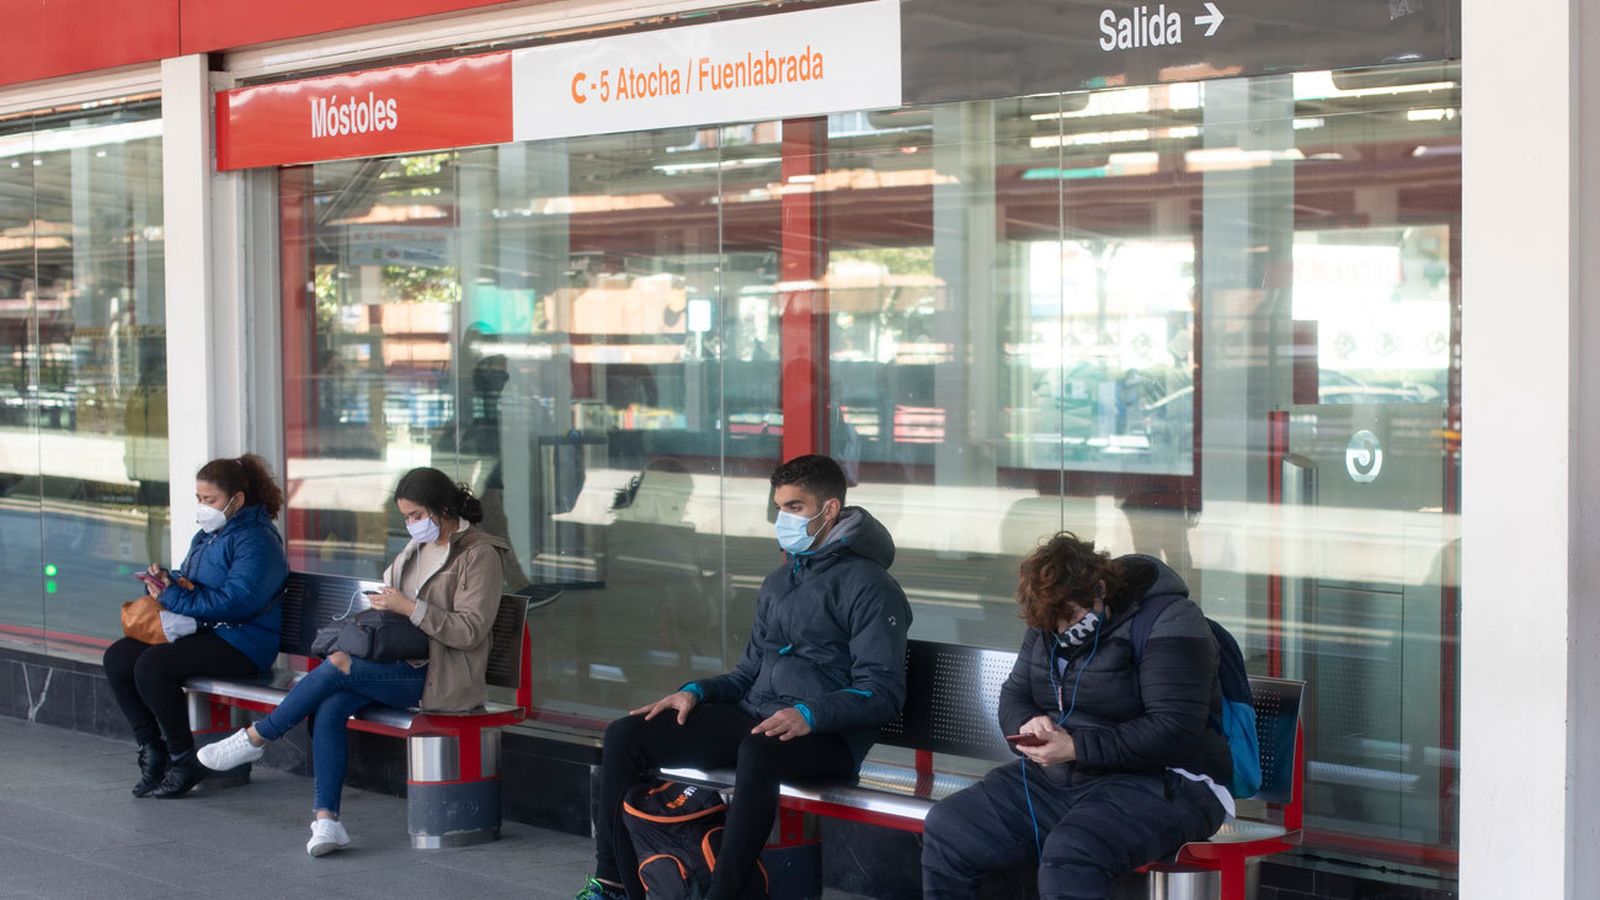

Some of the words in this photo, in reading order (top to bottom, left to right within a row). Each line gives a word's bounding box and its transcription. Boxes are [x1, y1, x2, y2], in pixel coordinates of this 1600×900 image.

[1099, 3, 1182, 51] Salida
[615, 63, 681, 100] Atocha
[698, 45, 824, 92] Fuenlabrada
[310, 91, 398, 138] Móstoles
